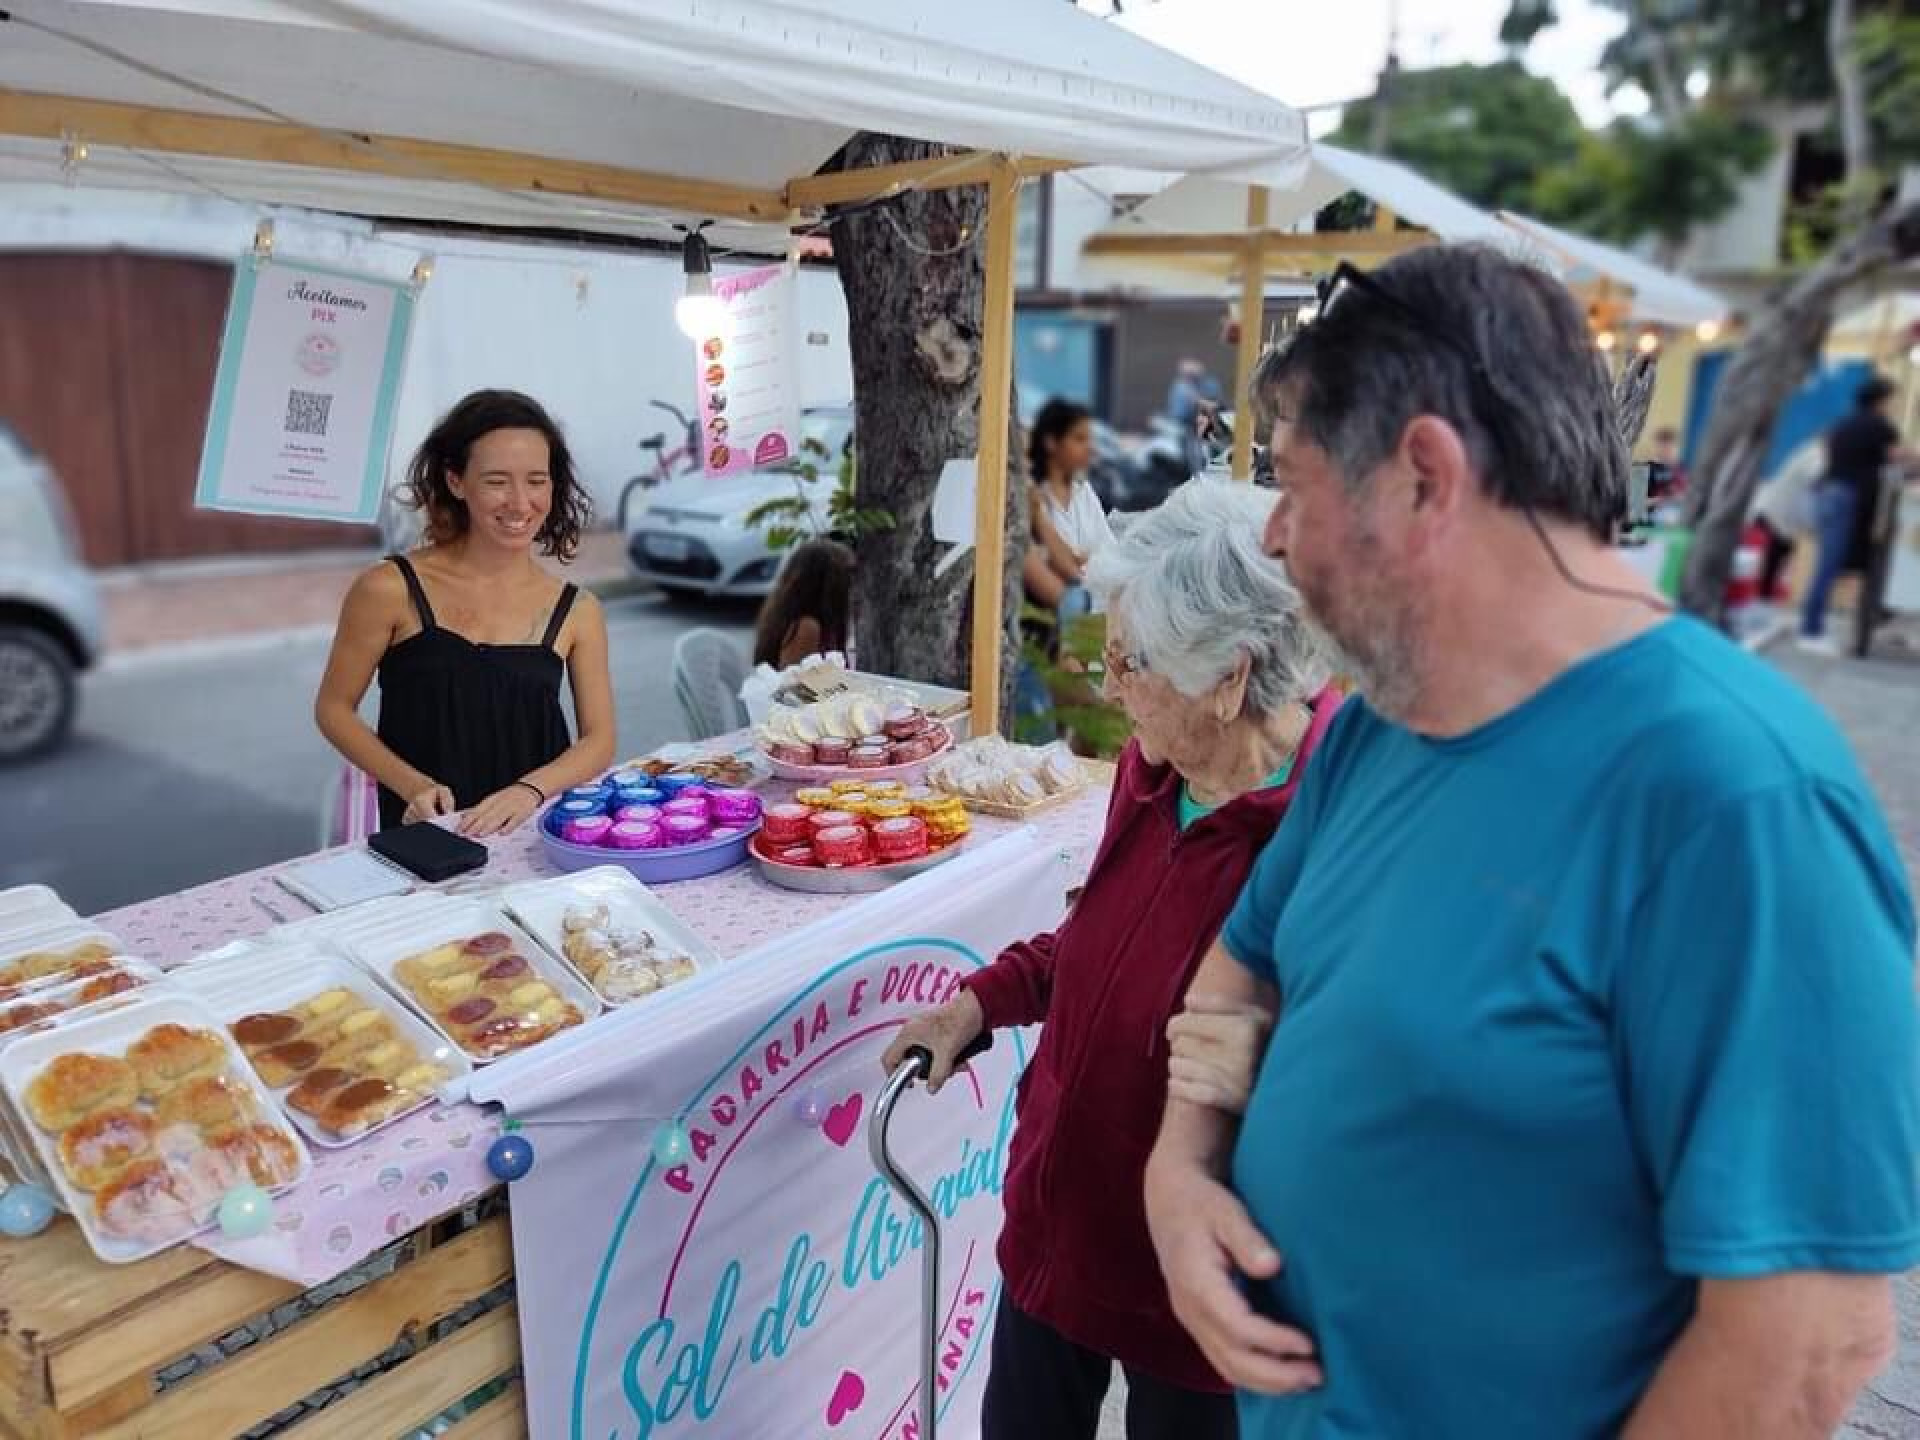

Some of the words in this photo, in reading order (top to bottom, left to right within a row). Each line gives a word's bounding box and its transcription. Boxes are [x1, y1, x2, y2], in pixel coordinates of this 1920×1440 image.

[287, 280, 367, 311] Aceitamos
[664, 1000, 829, 1193] PADARIA
[848, 978, 867, 1016] E
[609, 1259, 742, 1440] Sol
[751, 1232, 836, 1363] de
